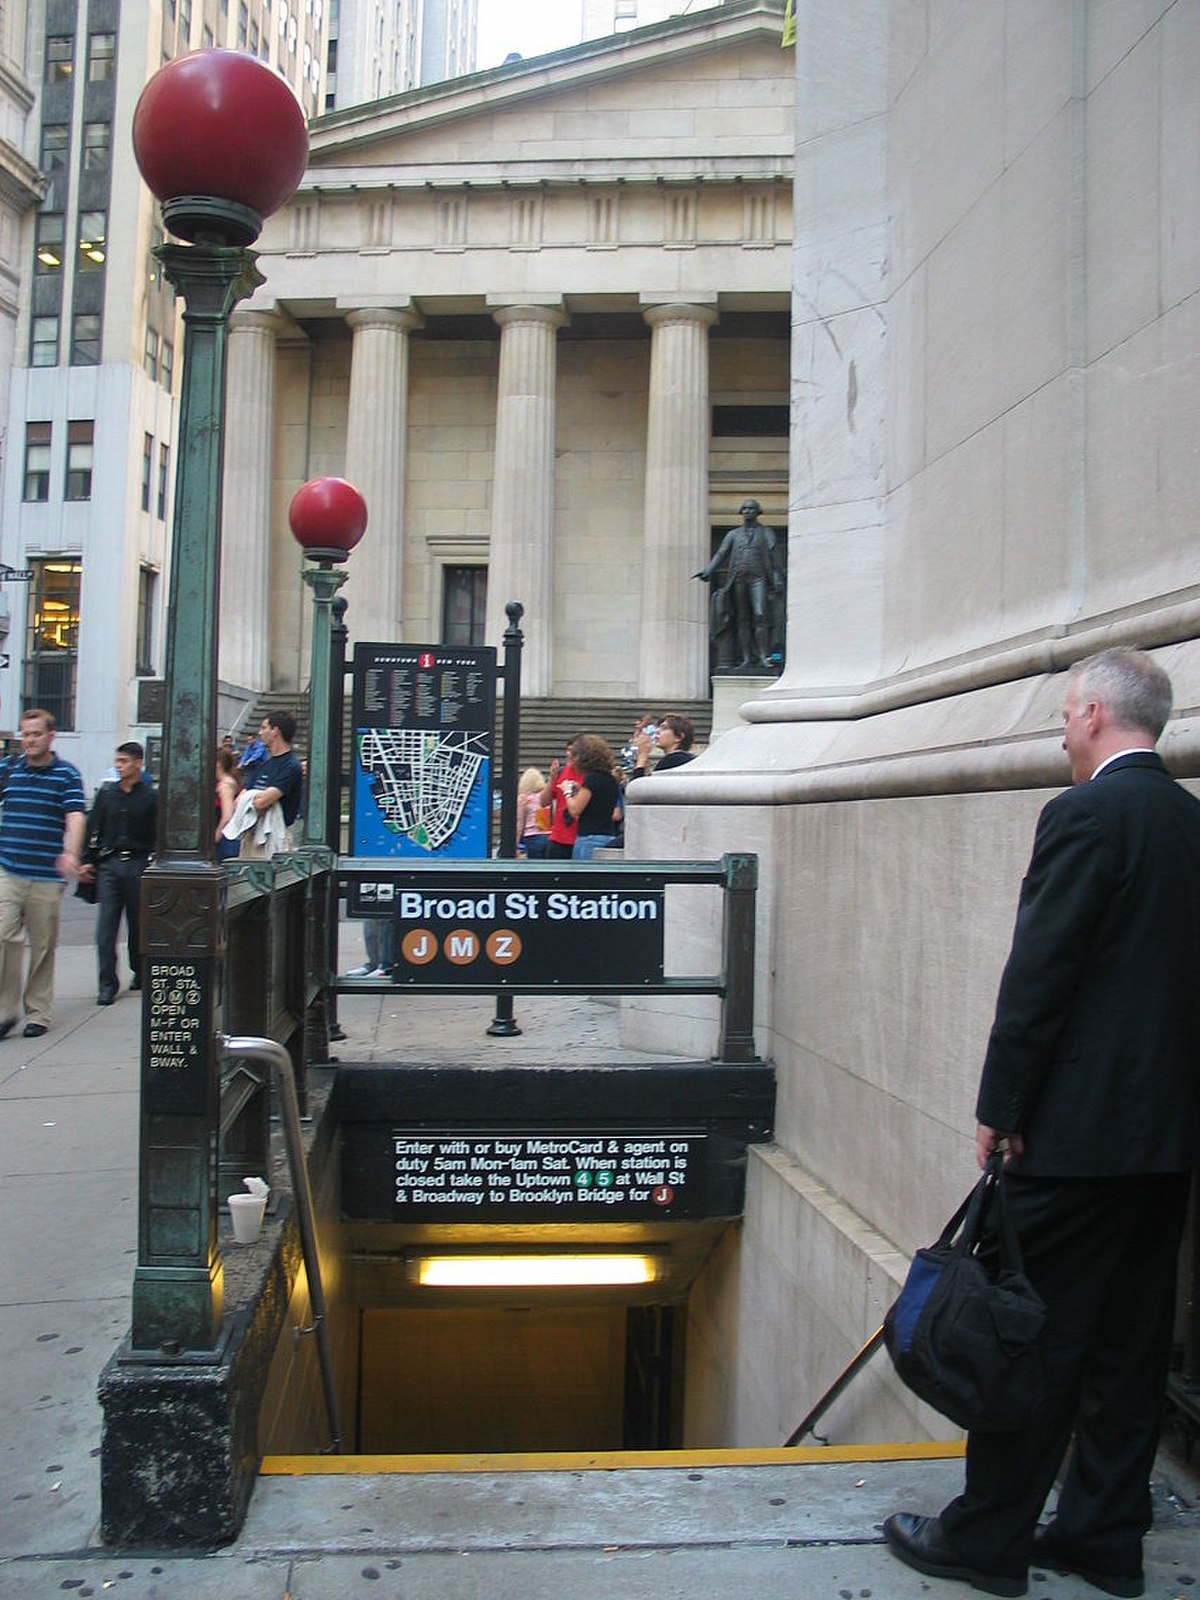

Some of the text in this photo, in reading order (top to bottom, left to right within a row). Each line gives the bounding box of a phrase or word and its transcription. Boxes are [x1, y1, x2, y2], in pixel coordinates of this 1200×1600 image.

[400, 892, 657, 920] Broad St Station
[412, 936, 513, 957] J M Z
[151, 965, 195, 976] BROAD
[151, 978, 201, 989] ST. STA.
[151, 1004, 186, 1015] OPEN
[150, 1017, 199, 1029] M-F OR
[150, 1031, 192, 1042] ENTER
[150, 1044, 198, 1055] WALL &
[150, 1057, 188, 1068] BWAY.
[395, 1140, 688, 1156] Enter with or buy MetroCard & agent on
[395, 1157, 429, 1173] duty
[433, 1157, 467, 1170] 5am
[470, 1157, 538, 1170] Mon-1am
[575, 1156, 617, 1170] When
[621, 1156, 670, 1169] station
[674, 1156, 688, 1169] is
[395, 1173, 445, 1187] closed
[449, 1173, 483, 1187] take
[487, 1173, 512, 1187] the
[516, 1173, 571, 1188] Uptown
[615, 1172, 631, 1185] at
[635, 1172, 665, 1185] Wall
[668, 1171, 686, 1185] St
[395, 1189, 408, 1202] &
[412, 1189, 485, 1205] Broadway
[489, 1190, 505, 1202] to
[509, 1189, 573, 1204] Brooklyn
[577, 1188, 624, 1204] Bridge
[629, 1188, 650, 1201] for
